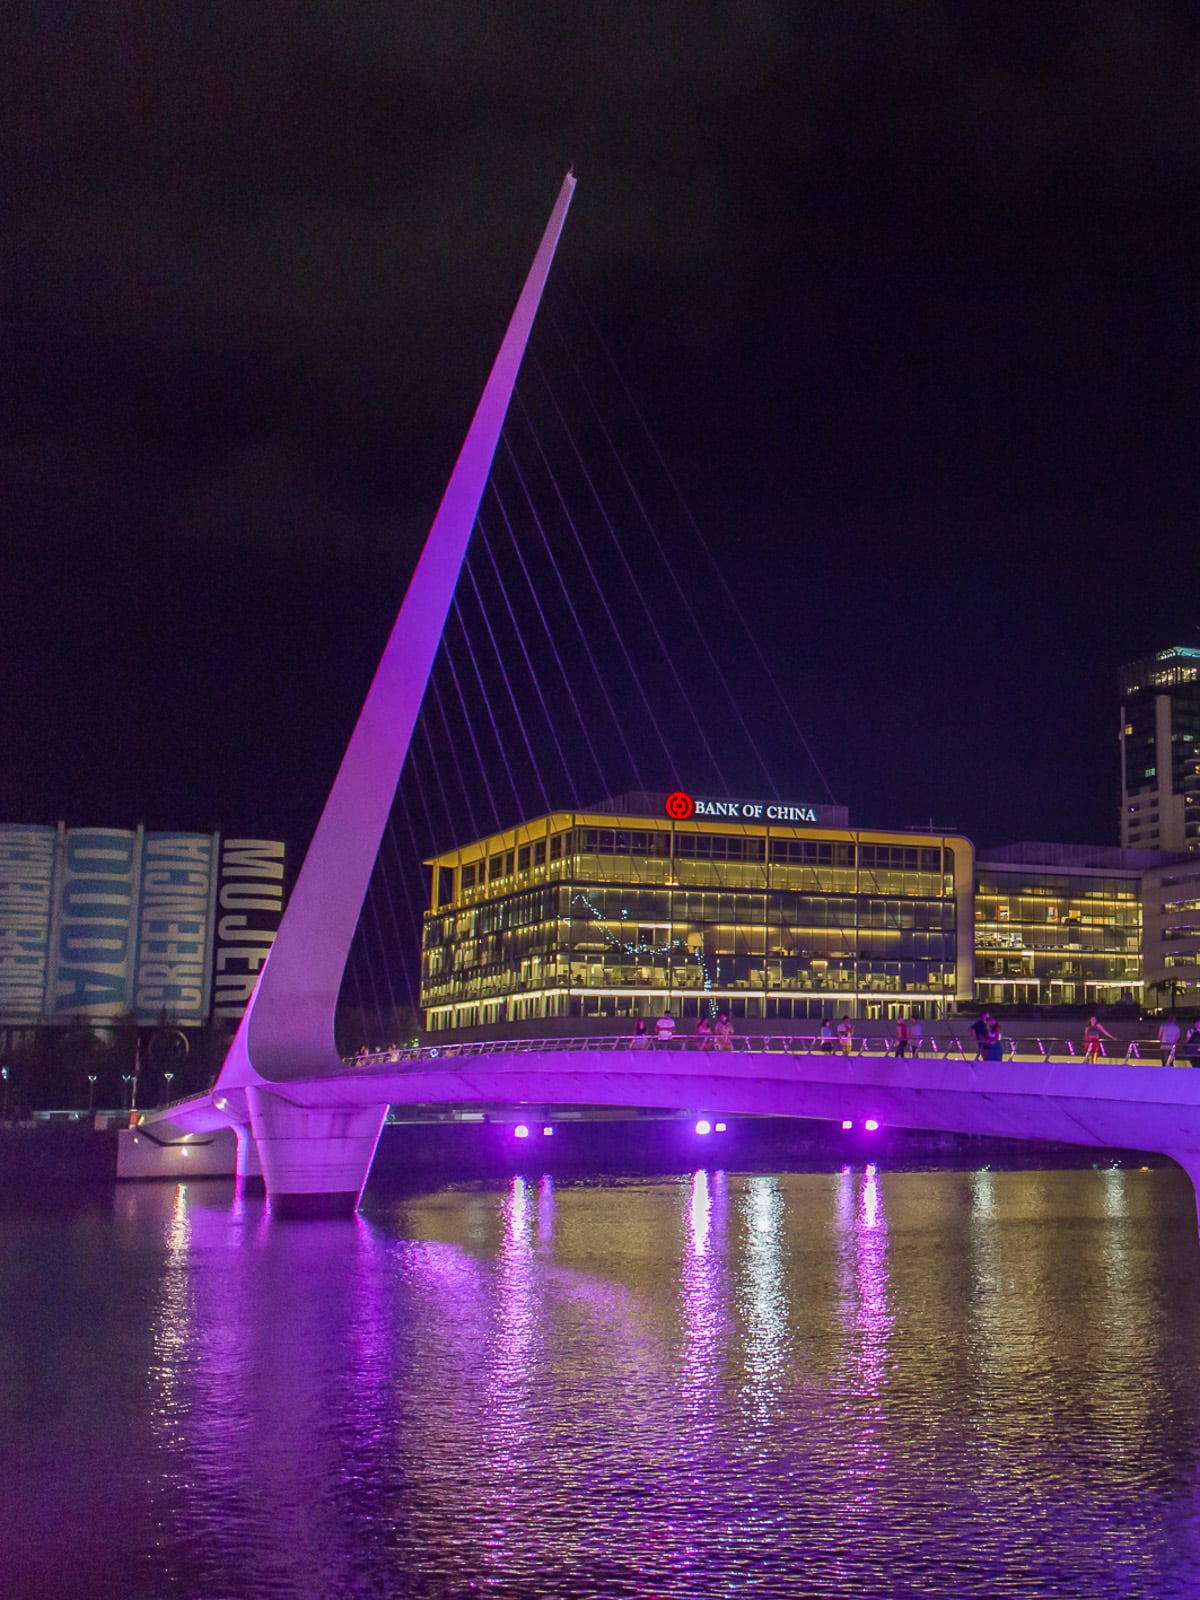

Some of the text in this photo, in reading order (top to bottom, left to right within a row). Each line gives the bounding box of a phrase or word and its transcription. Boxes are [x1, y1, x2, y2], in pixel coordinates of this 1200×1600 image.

[694, 801, 817, 822] BANK OF CHINA
[136, 838, 211, 1010] CREENCIA
